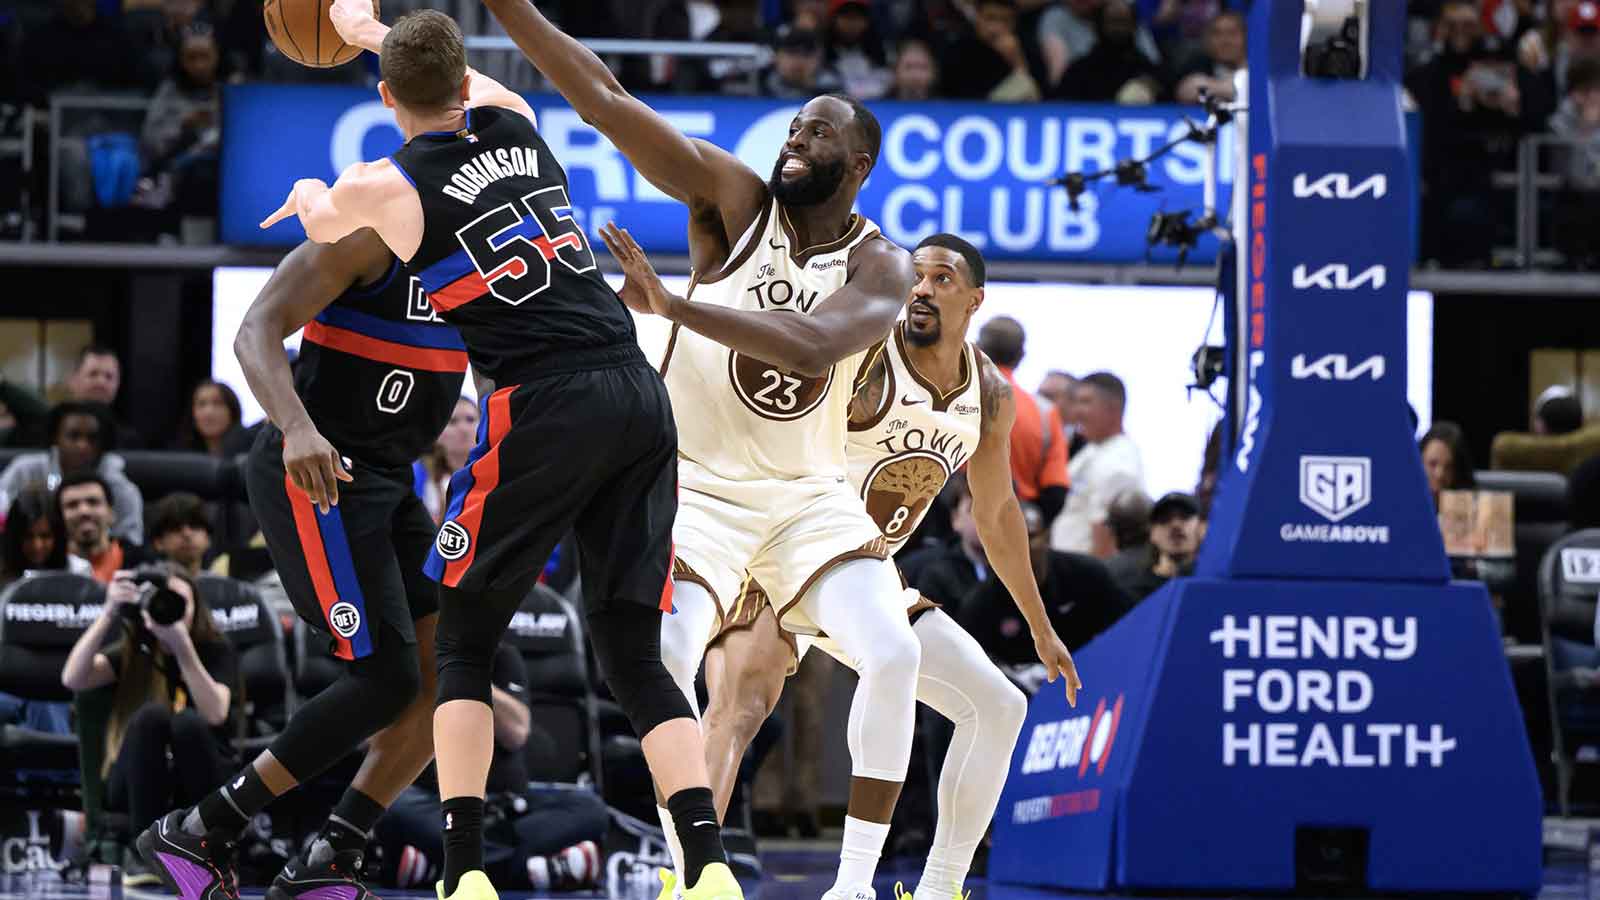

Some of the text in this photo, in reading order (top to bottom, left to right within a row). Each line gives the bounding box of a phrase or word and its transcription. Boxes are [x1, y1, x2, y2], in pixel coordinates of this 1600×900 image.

[442, 146, 539, 206] ROBINSON
[881, 185, 1099, 252] CLUB
[456, 185, 597, 306] 55
[811, 258, 847, 271] Rakuten
[756, 263, 776, 280] The
[376, 369, 415, 415] 0
[753, 369, 802, 411] 23
[885, 418, 909, 434] The
[876, 428, 967, 470] TOWN
[440, 530, 463, 549] DET
[885, 505, 909, 534] 8
[1280, 523, 1390, 543] GAMEABOVE
[334, 611, 354, 627] DET
[1210, 615, 1418, 661] HENRY
[1223, 669, 1374, 713] FORD
[1222, 723, 1457, 767] HEALTH
